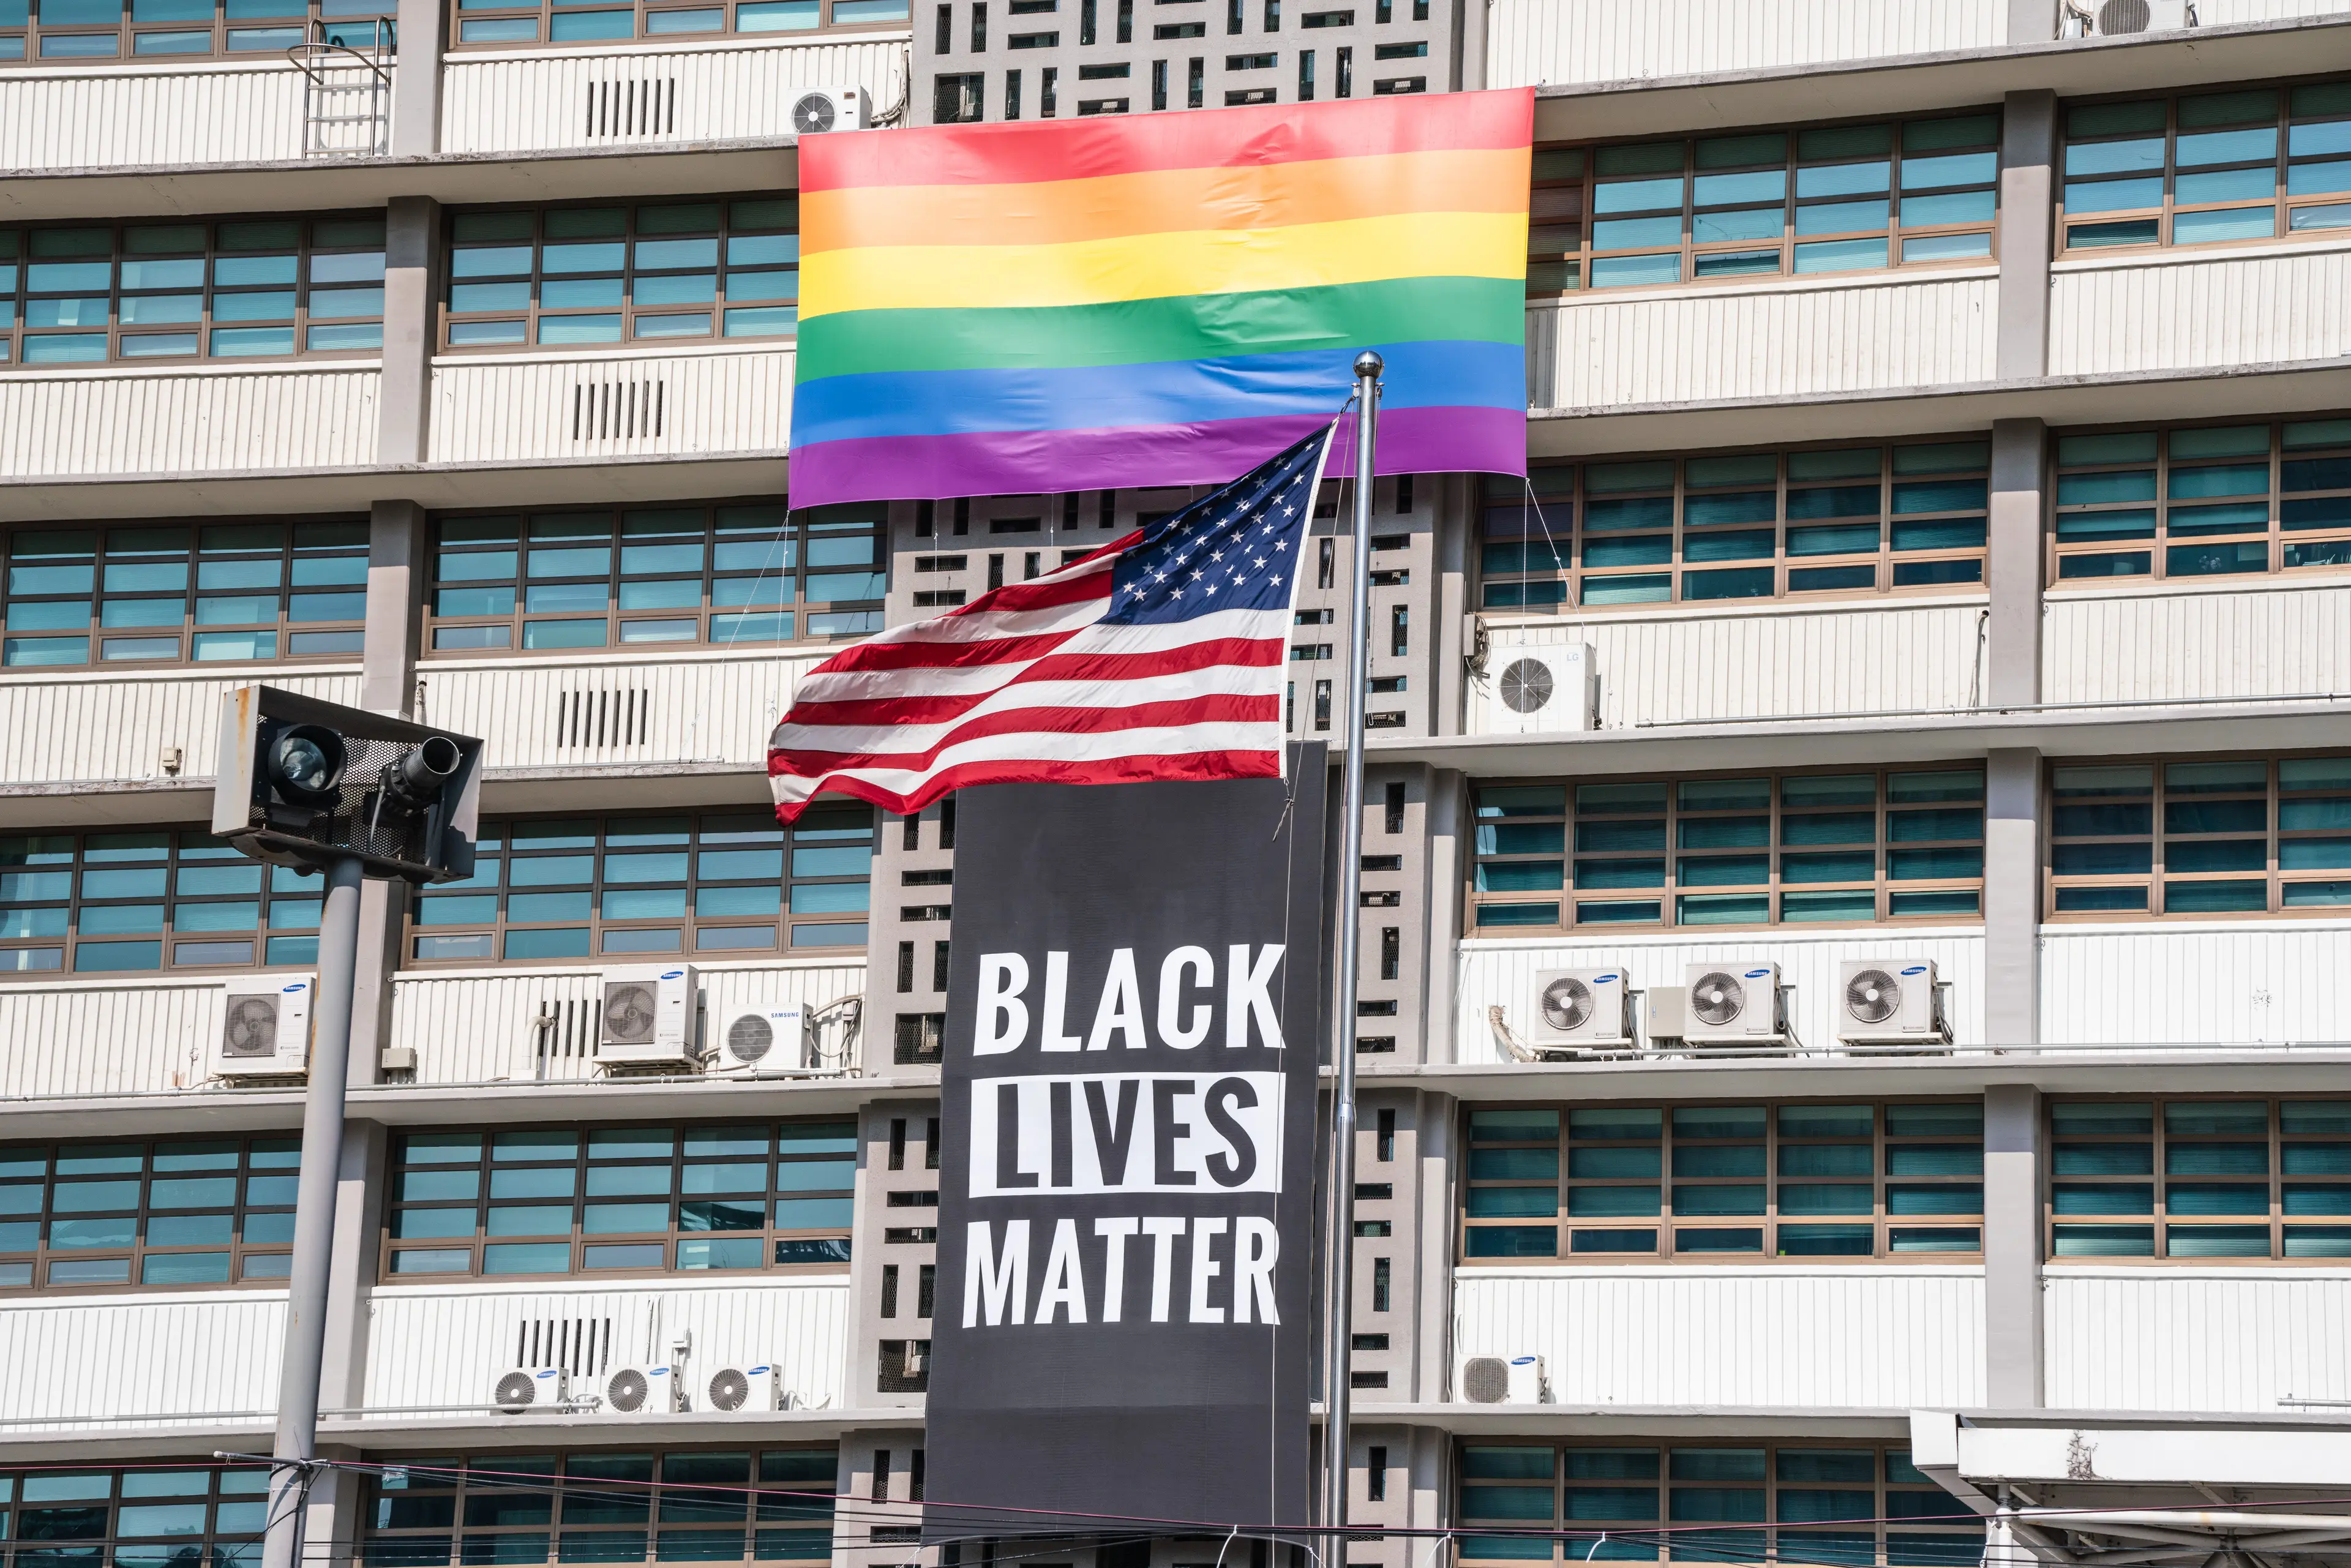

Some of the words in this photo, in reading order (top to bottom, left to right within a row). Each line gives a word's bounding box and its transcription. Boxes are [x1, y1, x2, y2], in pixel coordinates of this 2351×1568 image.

[1567, 653, 1579, 661] LG
[973, 943, 1286, 1056] BLACK
[996, 1076, 1259, 1189] LIVES
[962, 1216, 1281, 1328] MATTER
